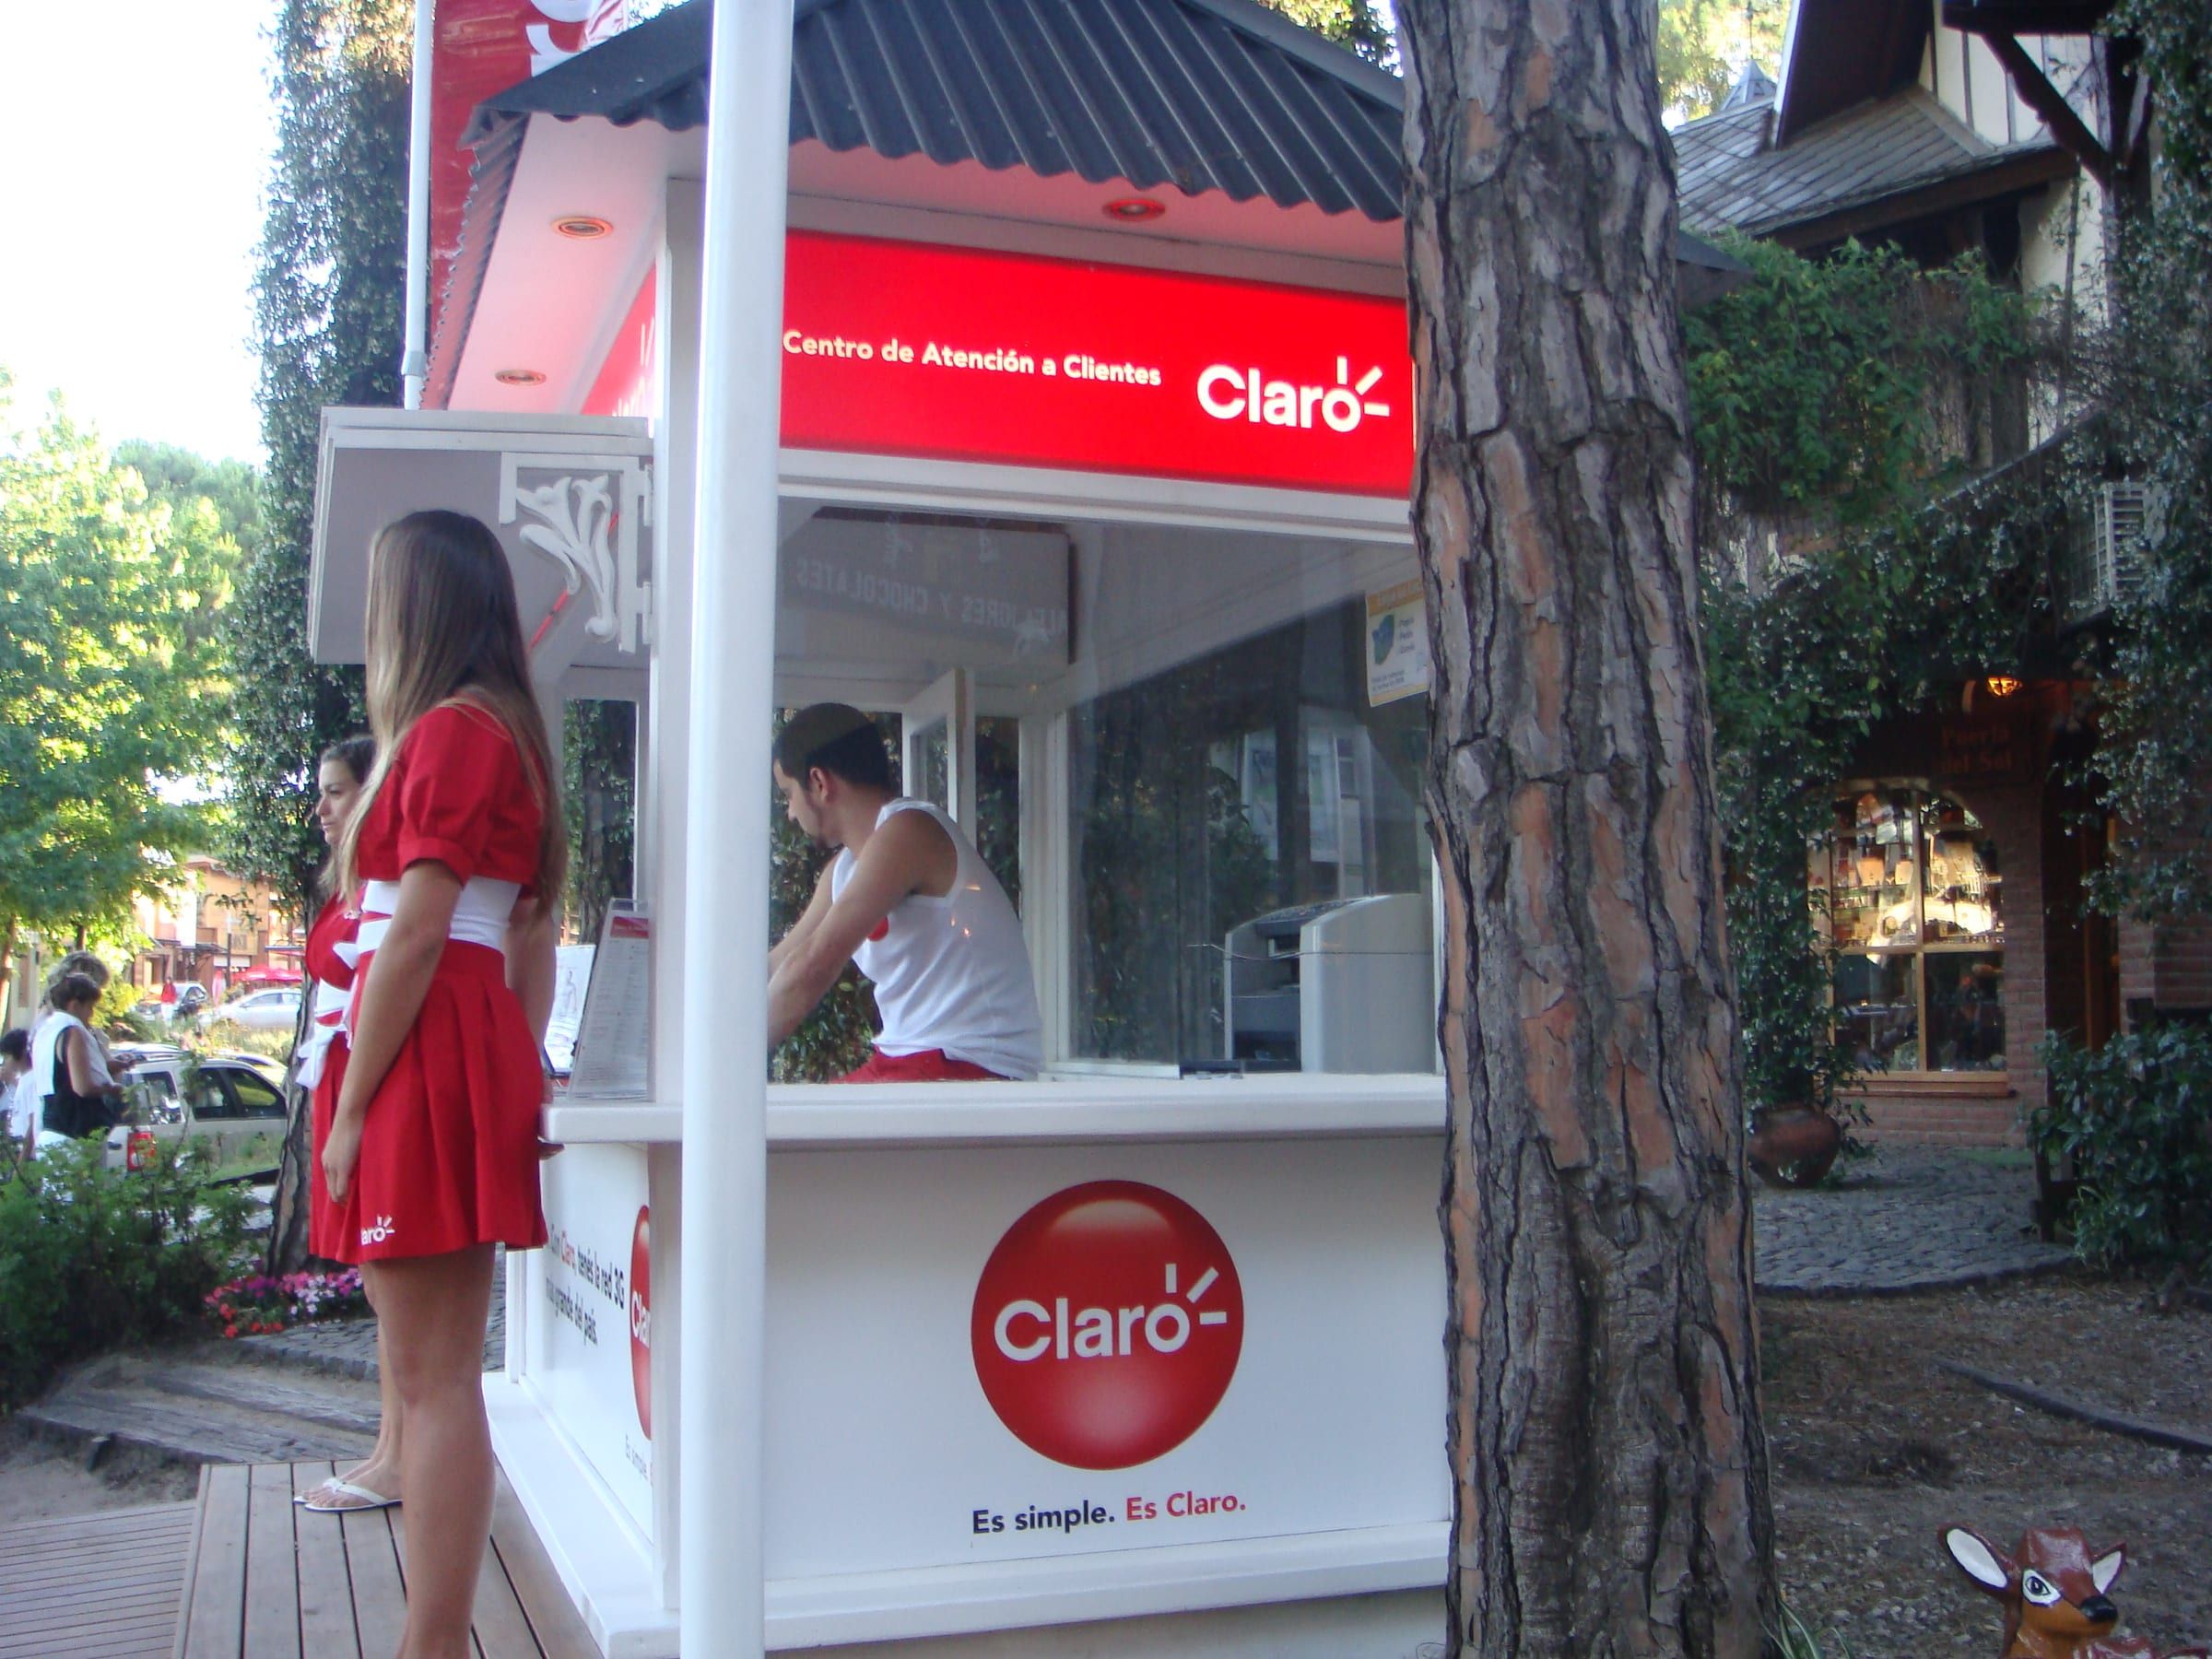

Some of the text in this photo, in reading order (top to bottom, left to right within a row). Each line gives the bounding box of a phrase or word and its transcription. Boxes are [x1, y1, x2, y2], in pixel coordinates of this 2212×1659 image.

[782, 330, 1161, 386] Centro de Atención a Clientes
[1197, 364, 1362, 432] Claro
[632, 1290, 651, 1348] Cla
[994, 1297, 1191, 1362] Claro
[973, 1490, 1246, 1534] Es simple. Es Claro.
